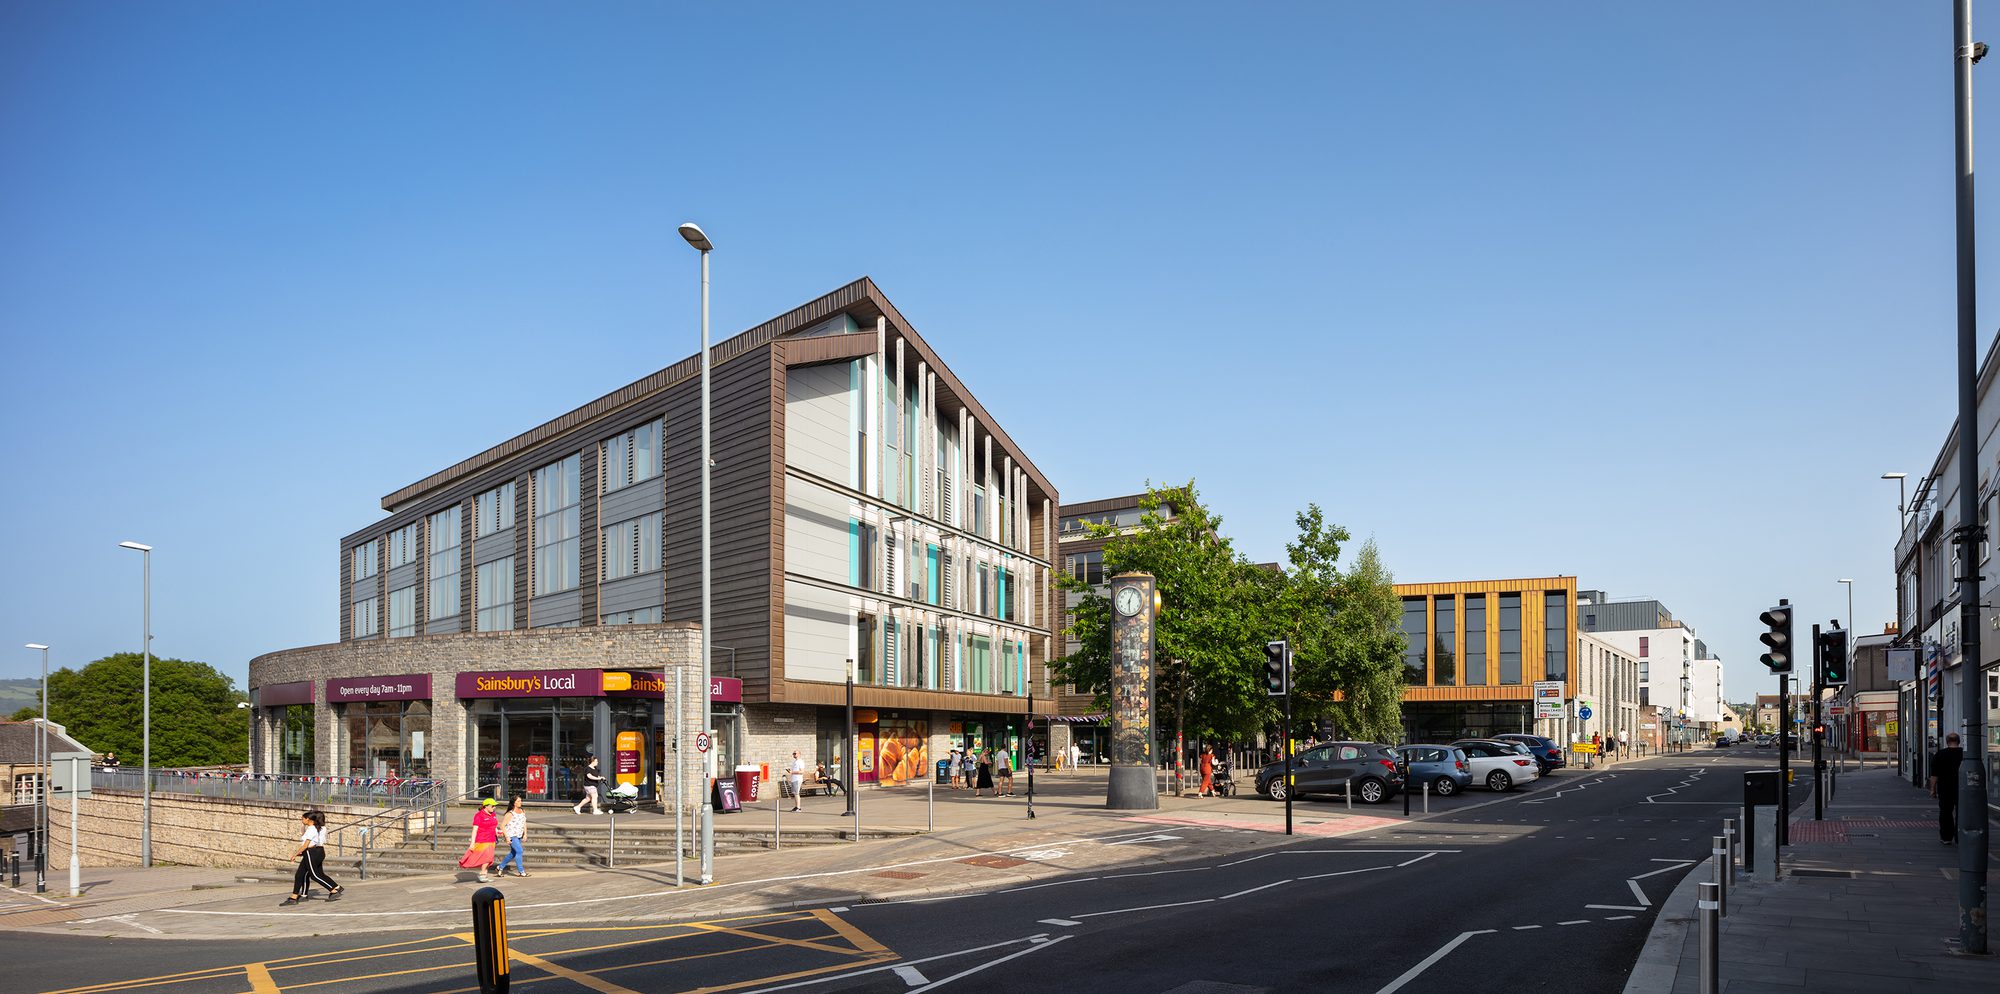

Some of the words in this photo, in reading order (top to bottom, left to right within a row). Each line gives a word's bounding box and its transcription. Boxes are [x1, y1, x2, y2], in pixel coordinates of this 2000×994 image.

[340, 686, 354, 696] Open
[354, 687, 370, 696] every
[370, 685, 380, 696] day
[381, 684, 394, 693] 7am
[397, 684, 413, 694] 11pm
[477, 676, 541, 693] Sainsbury's
[544, 673, 575, 689] Local
[632, 677, 665, 691] ainsb
[698, 739, 707, 747] 20
[750, 776, 758, 798] COSTA
